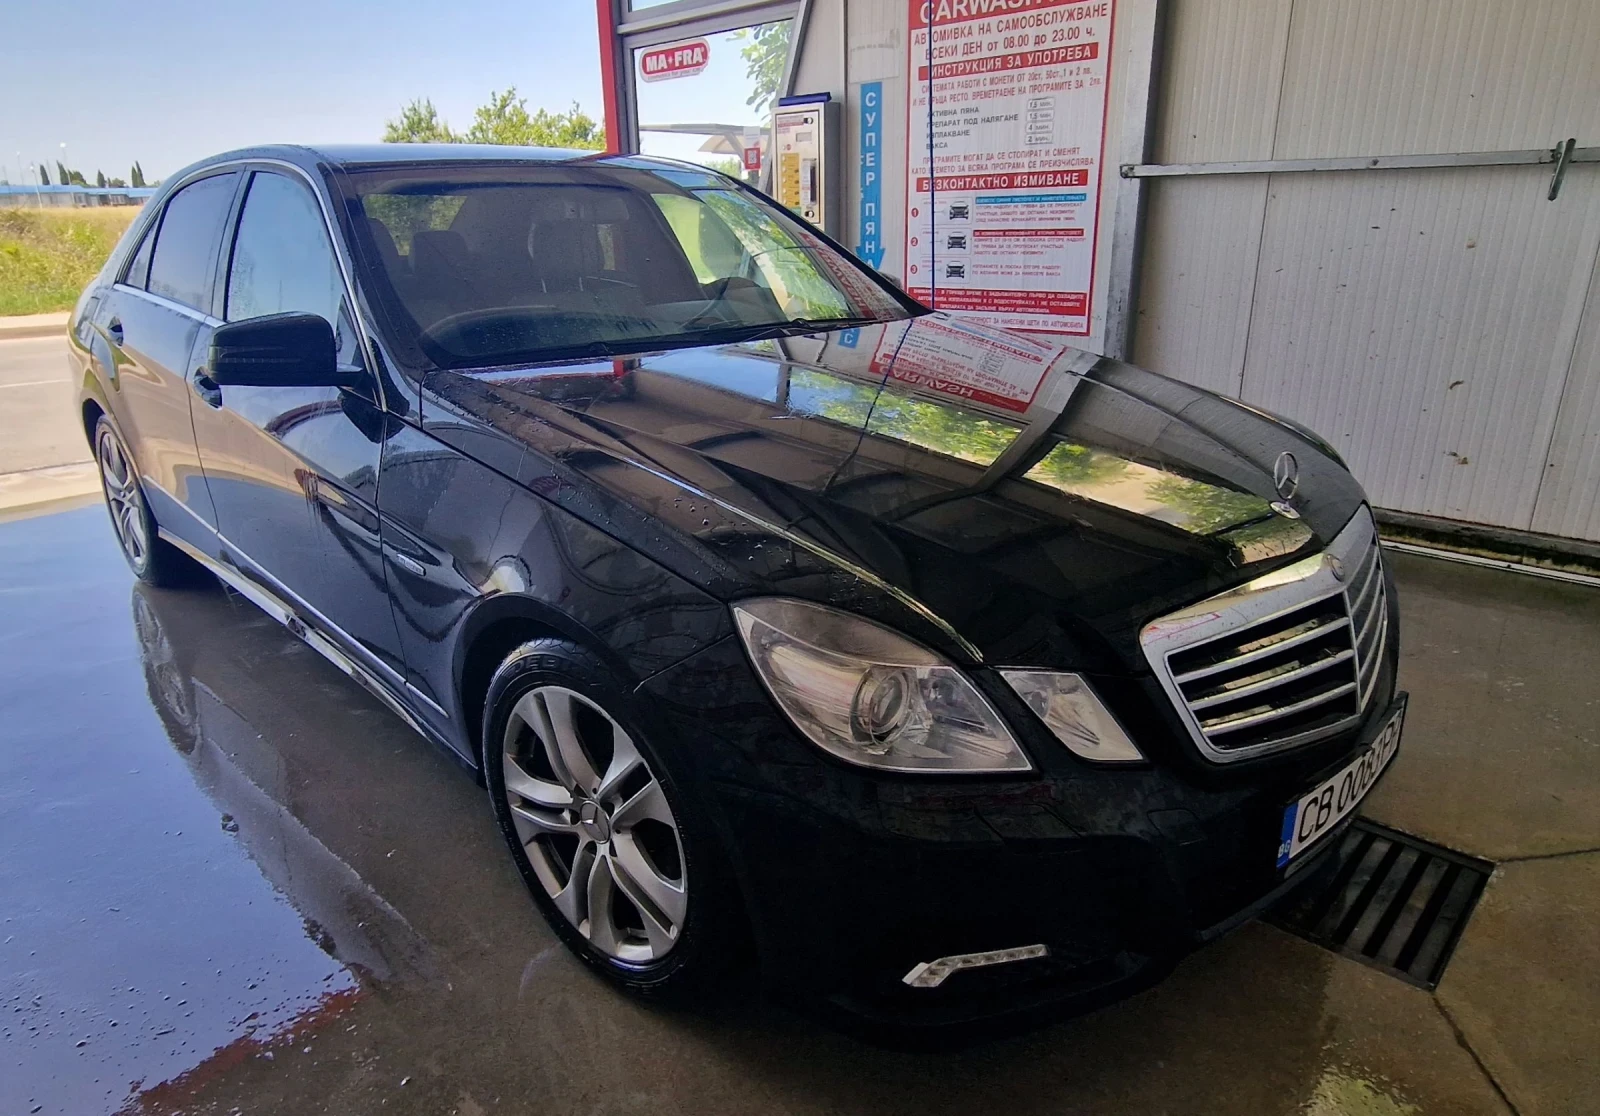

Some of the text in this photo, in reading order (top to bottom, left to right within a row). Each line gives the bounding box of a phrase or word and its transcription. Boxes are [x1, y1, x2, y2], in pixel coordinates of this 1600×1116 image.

[978, 24, 992, 34] НА
[996, 3, 1108, 33] САМООБСЛУЖВАНЕ
[962, 41, 982, 56] ДЕН
[987, 42, 998, 52] от
[1004, 34, 1030, 49] 08.00
[1034, 34, 1046, 46] до
[1052, 26, 1080, 42] 23.00
[1086, 27, 1096, 36] ч.
[932, 46, 1091, 78] ИНСТРУКЦИЯ ЗА УПОТРЕБА
[922, 83, 955, 94] СИТЕМАТА
[957, 79, 980, 88] РАБОТИ
[1028, 80, 1072, 94] ПРОГРАМИТЕ
[960, 106, 980, 114] ПЯНА
[980, 114, 1018, 124] НАЛЯГАНЕ
[864, 92, 877, 186] СУПЕР
[963, 153, 983, 161] МОГАТ
[986, 152, 994, 160] ДА
[996, 152, 1006, 160] СЕ
[1008, 150, 1042, 158] СТОПИРАТ
[1052, 147, 1080, 156] СМЕНЯТ
[1028, 160, 1036, 168] СЕ
[1014, 172, 1079, 187] ИЗМИВАНЕ
